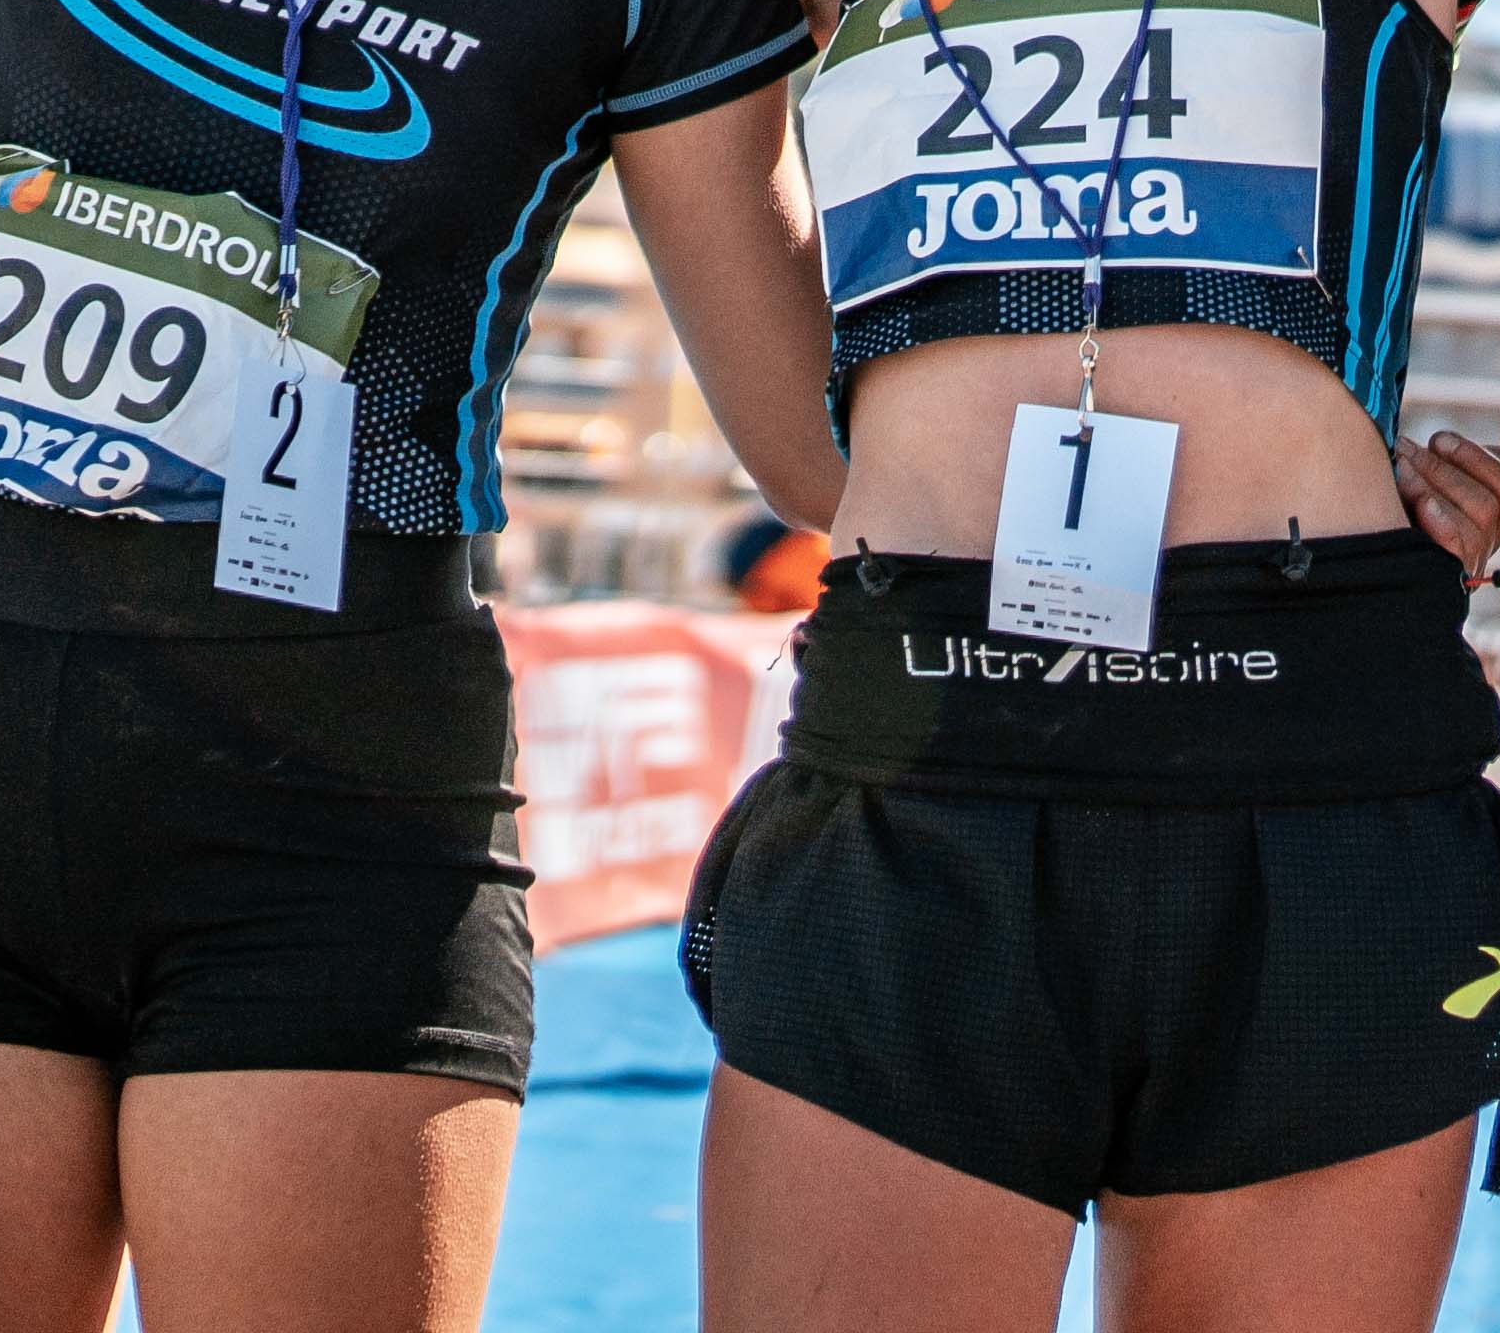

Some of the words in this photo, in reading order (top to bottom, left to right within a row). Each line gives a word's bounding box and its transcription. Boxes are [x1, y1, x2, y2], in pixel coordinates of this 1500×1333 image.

[916, 27, 1188, 157] 224
[906, 167, 1198, 259] Joma
[262, 380, 303, 491] 2
[1059, 425, 1095, 531] 1
